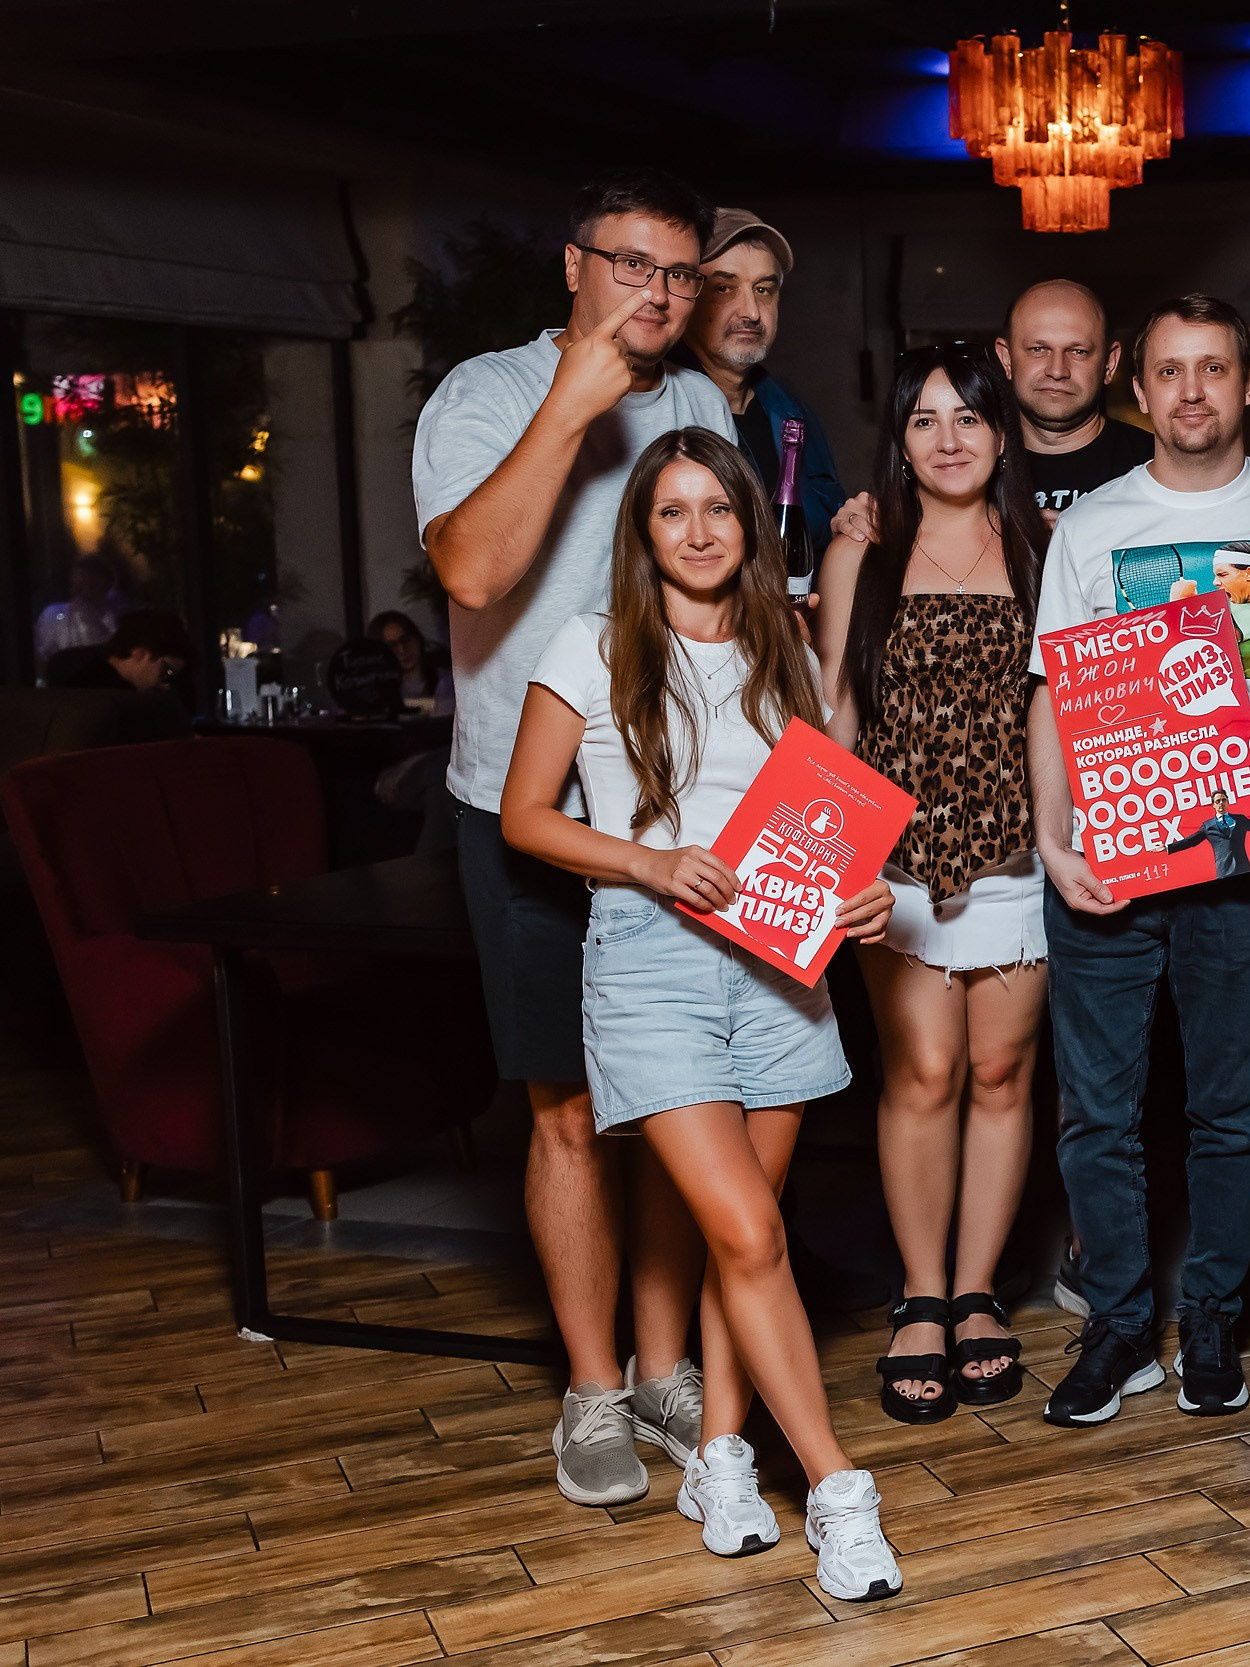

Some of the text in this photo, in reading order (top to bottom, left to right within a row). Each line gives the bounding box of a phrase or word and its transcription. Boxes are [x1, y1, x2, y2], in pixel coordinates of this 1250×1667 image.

[1054, 620, 1169, 667] 1 МЕСТО
[1159, 644, 1228, 690] КВИЗ,
[1165, 661, 1233, 710] ПЛИЗ!
[1072, 725, 1148, 753] КОМАНДЕ,
[1076, 724, 1219, 769] КОТОРАЯ РАЗНЕСЛА
[777, 821, 838, 865] КОФЕВАРНЯ
[1092, 816, 1185, 863] ВСЕХ
[745, 870, 825, 917] КВИЗ,
[1143, 863, 1169, 881] 117
[737, 894, 821, 937] ПЛИЗ!
